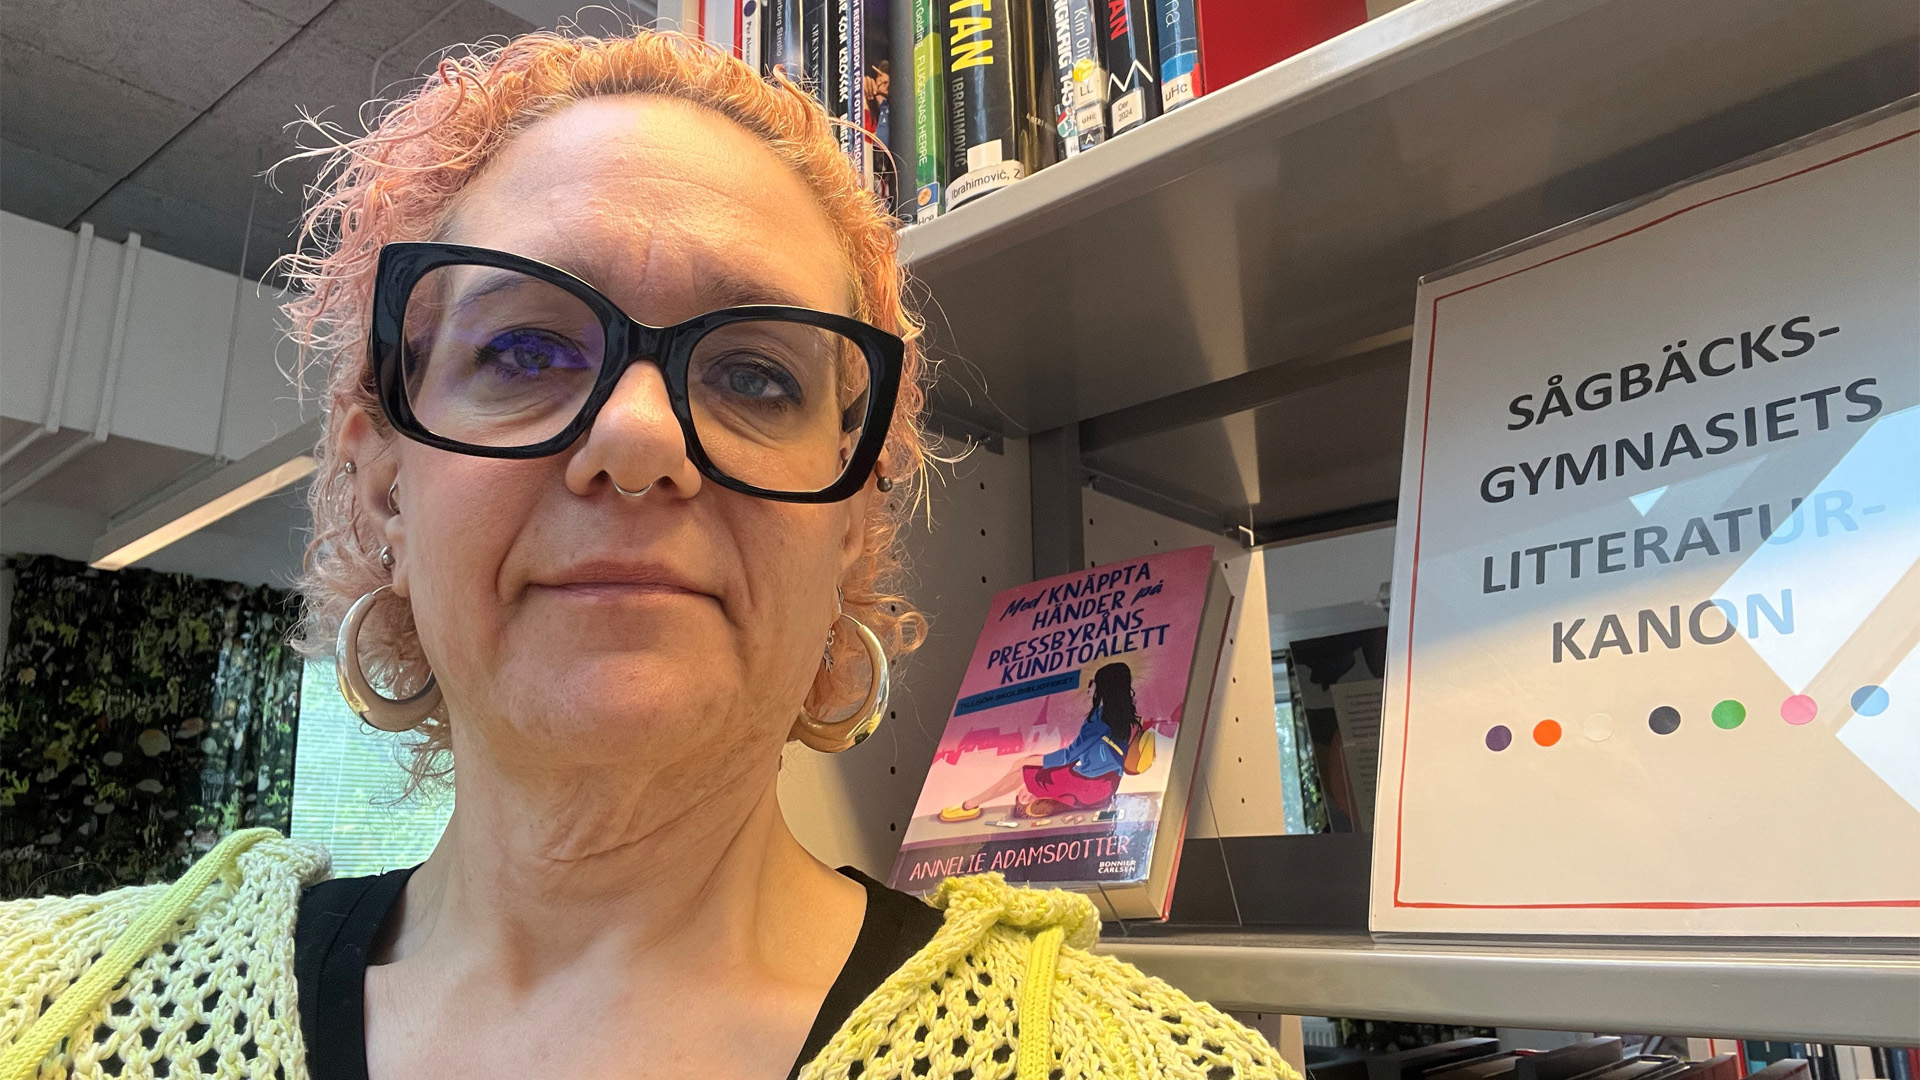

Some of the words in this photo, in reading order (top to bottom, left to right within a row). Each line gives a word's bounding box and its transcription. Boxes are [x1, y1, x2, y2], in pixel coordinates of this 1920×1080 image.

[776, 26, 784, 57] Strollo
[838, 16, 848, 44] SOM
[853, 8, 861, 70] REKORDBOK
[915, 7, 925, 51] Golding
[949, 0, 993, 72] TAN
[1074, 6, 1088, 36] Kim
[916, 54, 927, 125] FLUGORNAS
[1165, 83, 1188, 101] uHc
[917, 125, 928, 167] HERRE
[951, 169, 1010, 200] Ibrahimović,
[1506, 314, 1841, 431] SÅGBÄCKS-
[1479, 377, 1884, 504] GYMNASIETS
[1482, 488, 1887, 595] LITTERATUR-
[999, 589, 1047, 622] Med
[1047, 562, 1151, 606] KNÄPPTA
[1032, 590, 1126, 631] HÄNDER
[1130, 579, 1164, 606] på
[987, 608, 1145, 670] PRESSBYRÅNS
[1551, 588, 1796, 664] KANON
[1000, 623, 1171, 685] KUNDTOALETT
[909, 852, 987, 881] ANNELIE
[990, 835, 1131, 870] ADAMSDOTTER
[1098, 866, 1136, 874] CARLSEN
[1099, 860, 1137, 868] BONNIER
